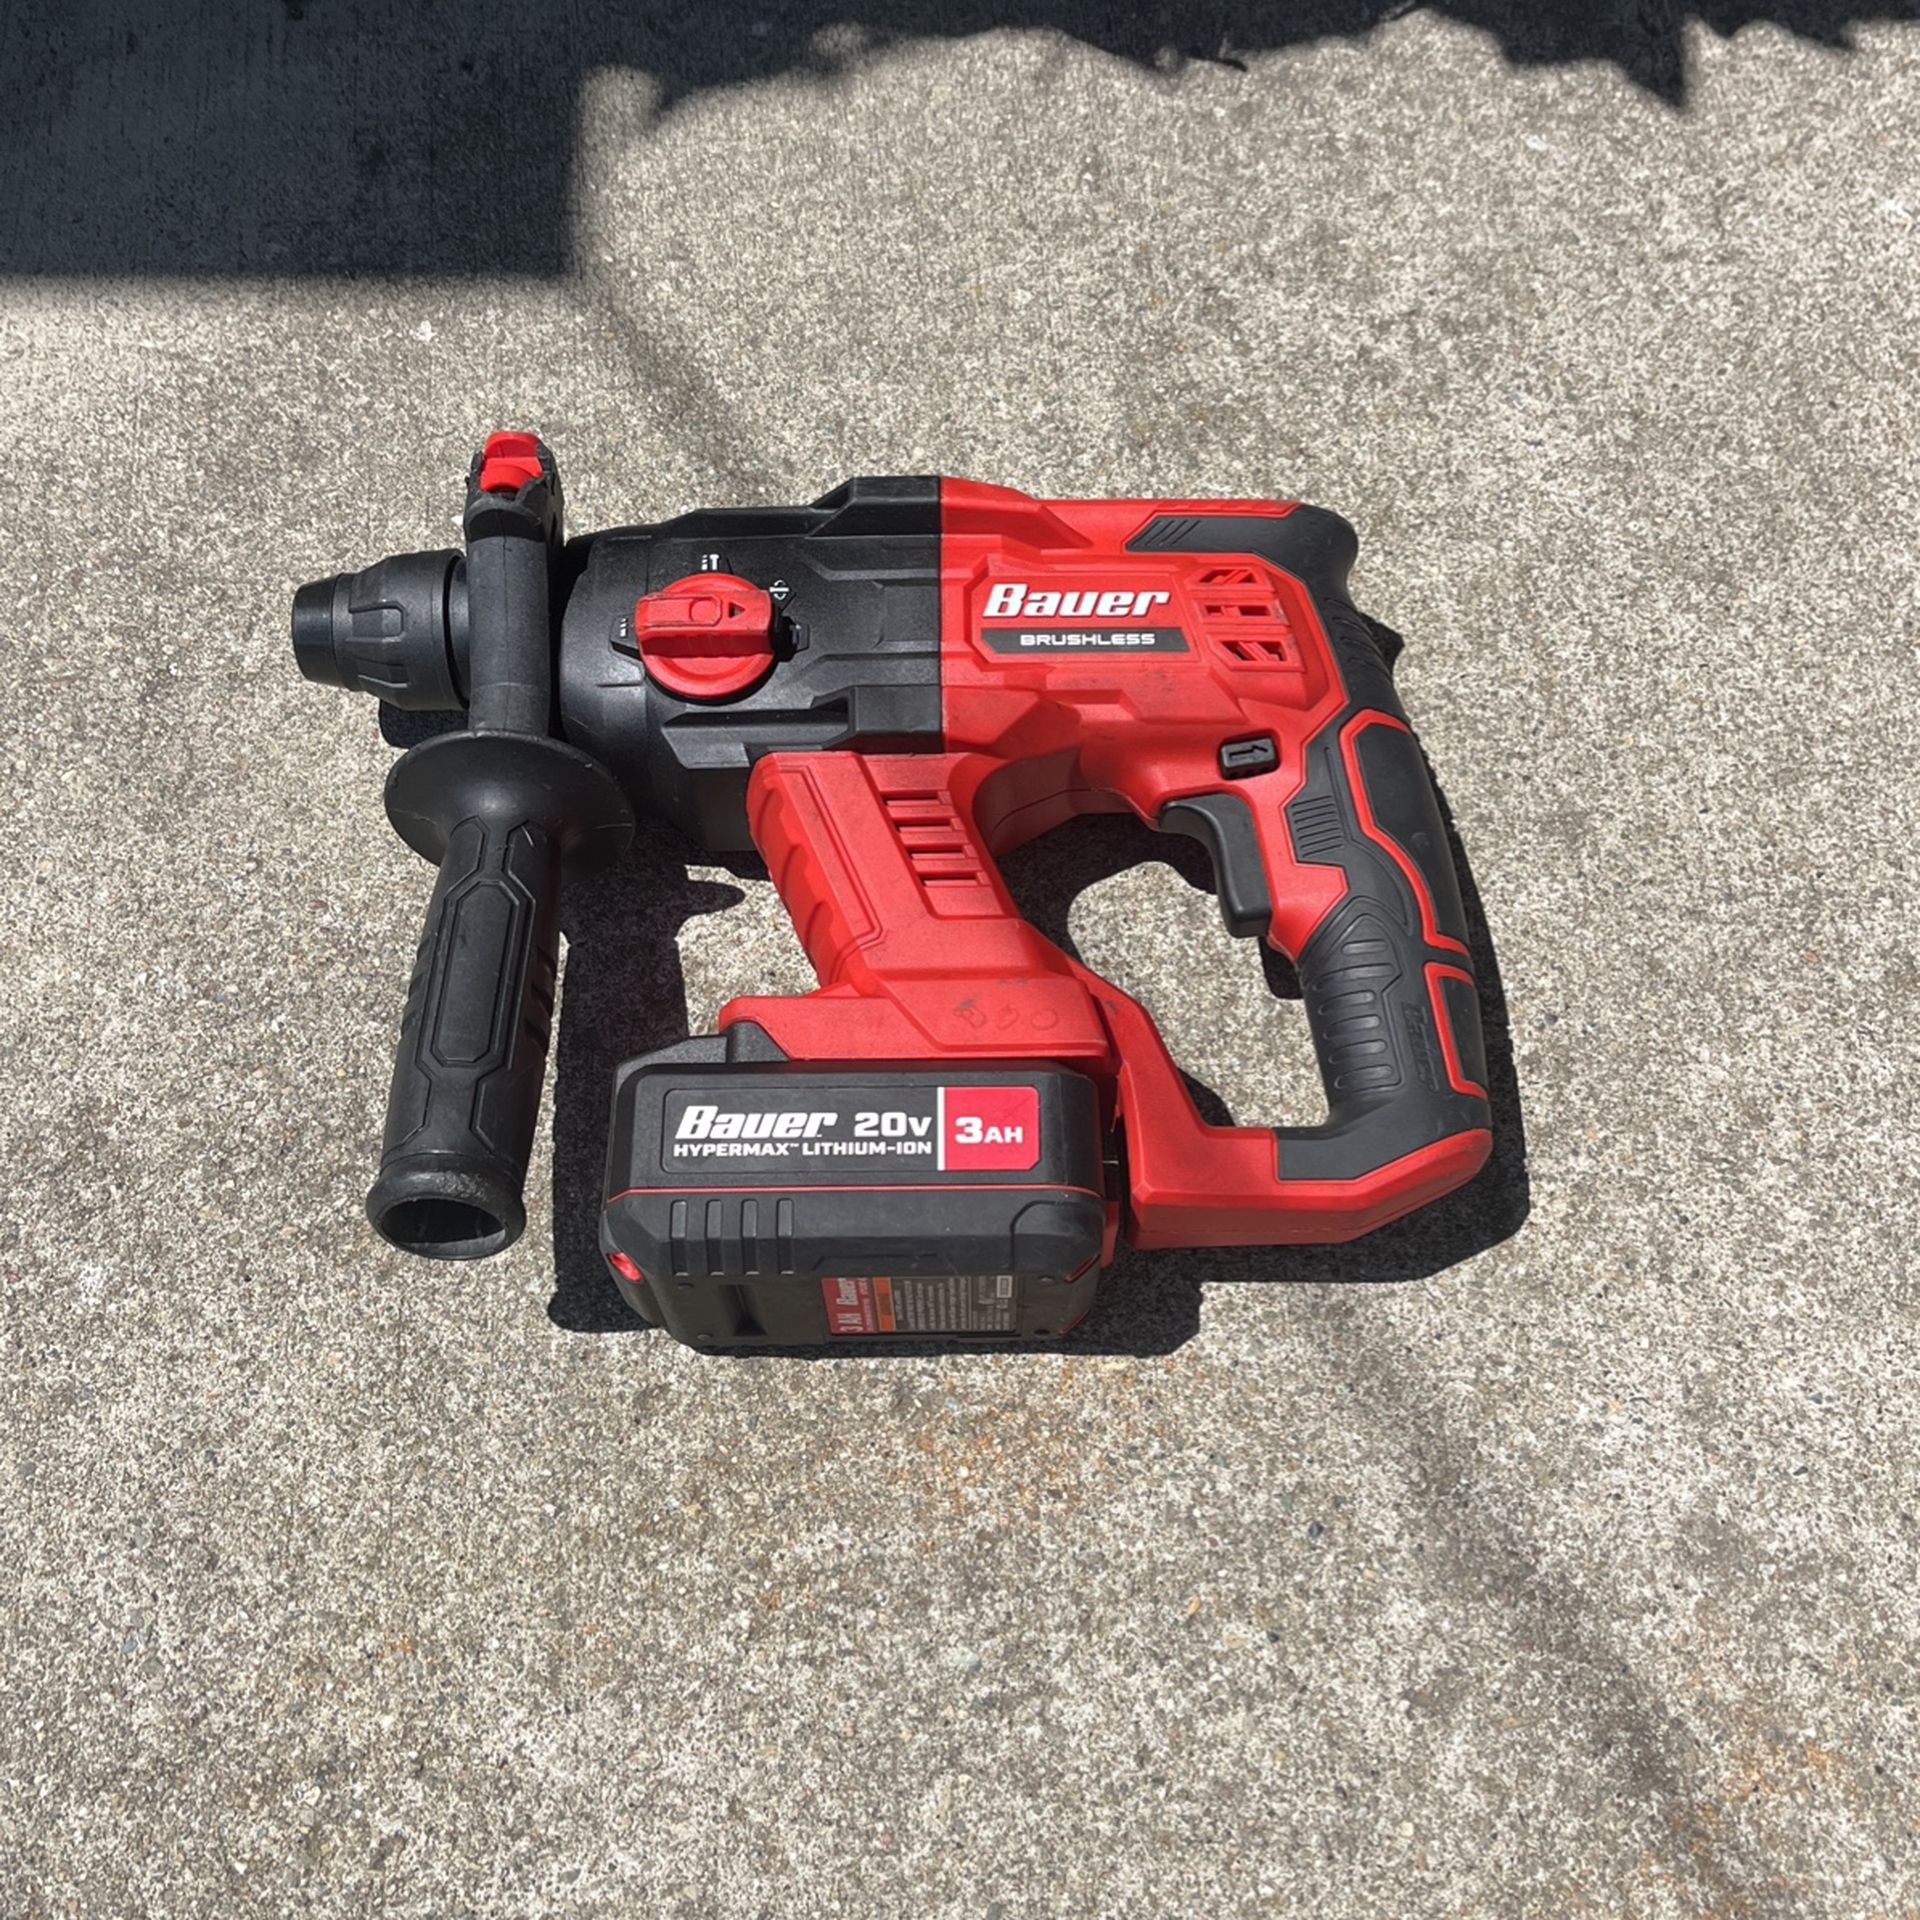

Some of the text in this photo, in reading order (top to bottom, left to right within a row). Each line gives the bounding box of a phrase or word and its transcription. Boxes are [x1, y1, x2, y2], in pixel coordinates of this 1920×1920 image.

[983, 583, 1170, 617] Bauer
[1020, 633, 1156, 647] BRUSHLESS
[674, 1105, 839, 1139] Bauer
[801, 1141, 932, 1156] LITHIUM-ION
